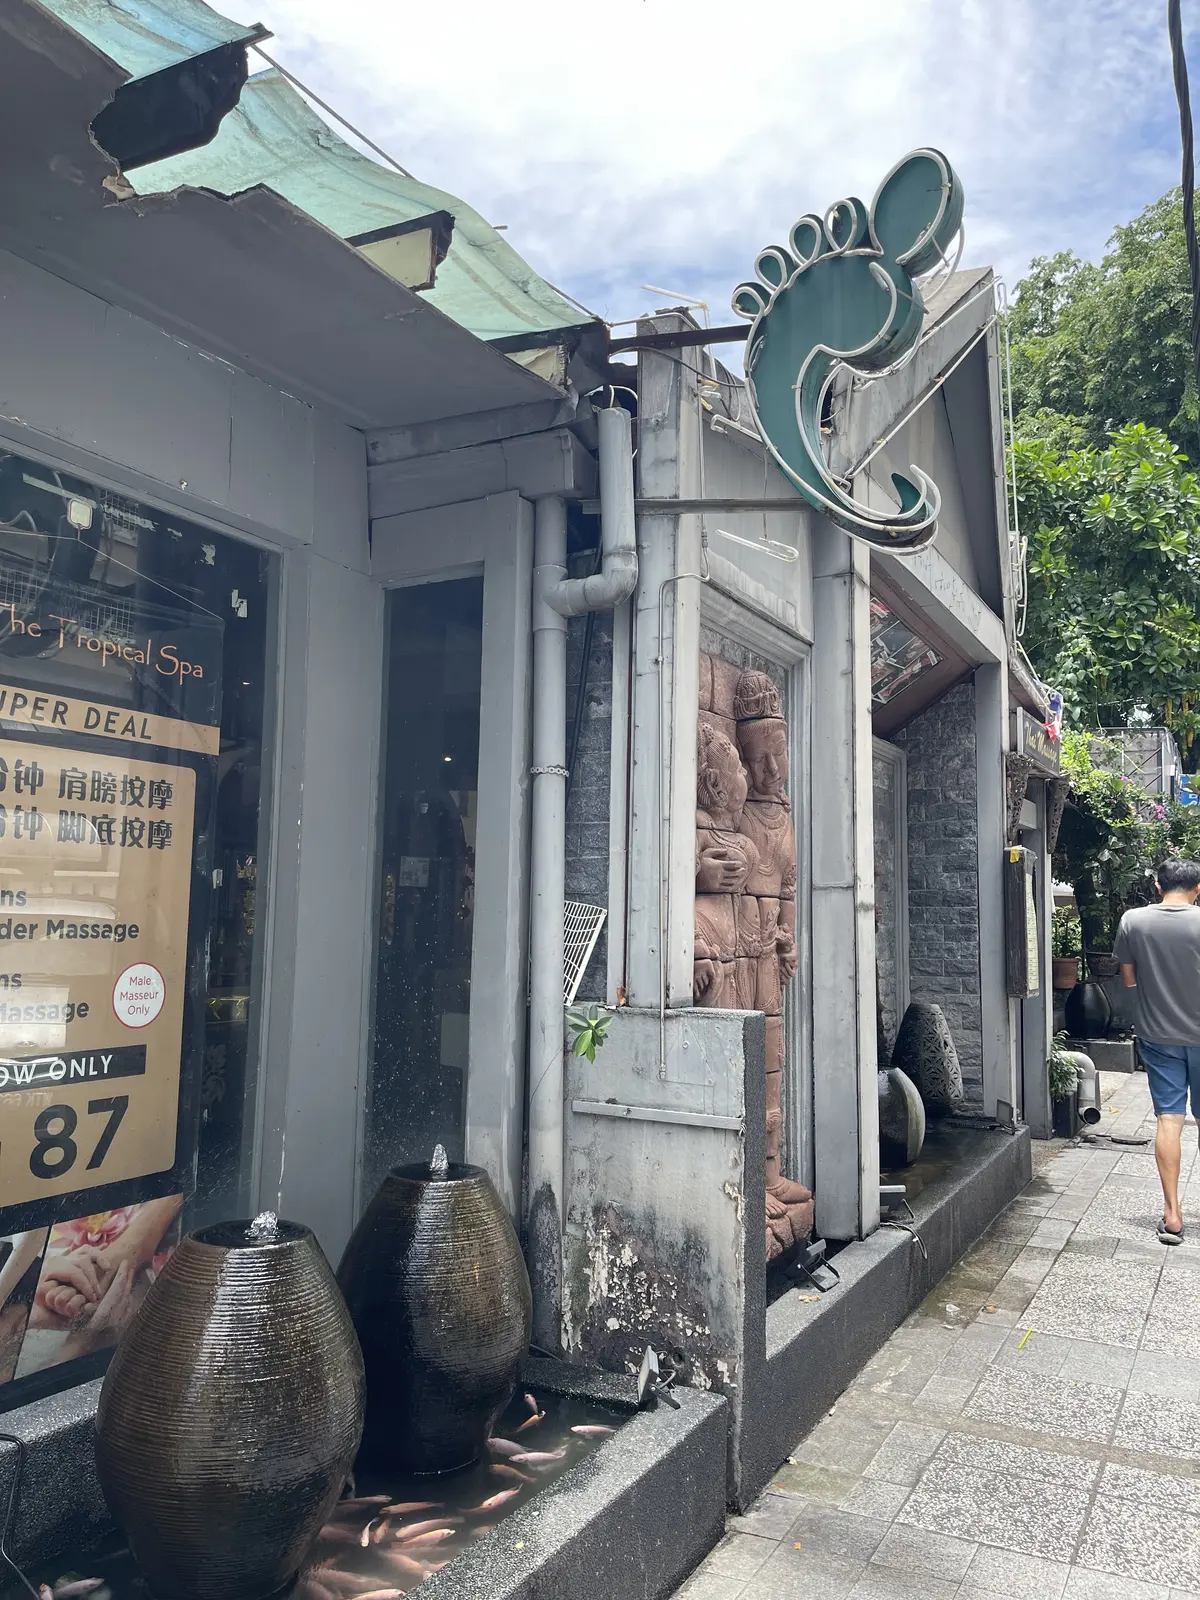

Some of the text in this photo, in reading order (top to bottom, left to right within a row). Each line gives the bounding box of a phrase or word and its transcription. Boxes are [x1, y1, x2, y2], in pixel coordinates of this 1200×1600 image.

[48, 614, 152, 667] Tropical
[155, 645, 204, 686] Spa
[84, 706, 153, 741] DEAL
[58, 766, 174, 811] 肩膀按摩
[57, 809, 173, 850] 脚底按摩
[46, 919, 140, 943] Massage
[120, 991, 159, 1002] Masseur
[129, 976, 152, 986] Male
[127, 1004, 151, 1016] Only
[49, 1054, 113, 1081] ONLY
[29, 1095, 130, 1180] 87
